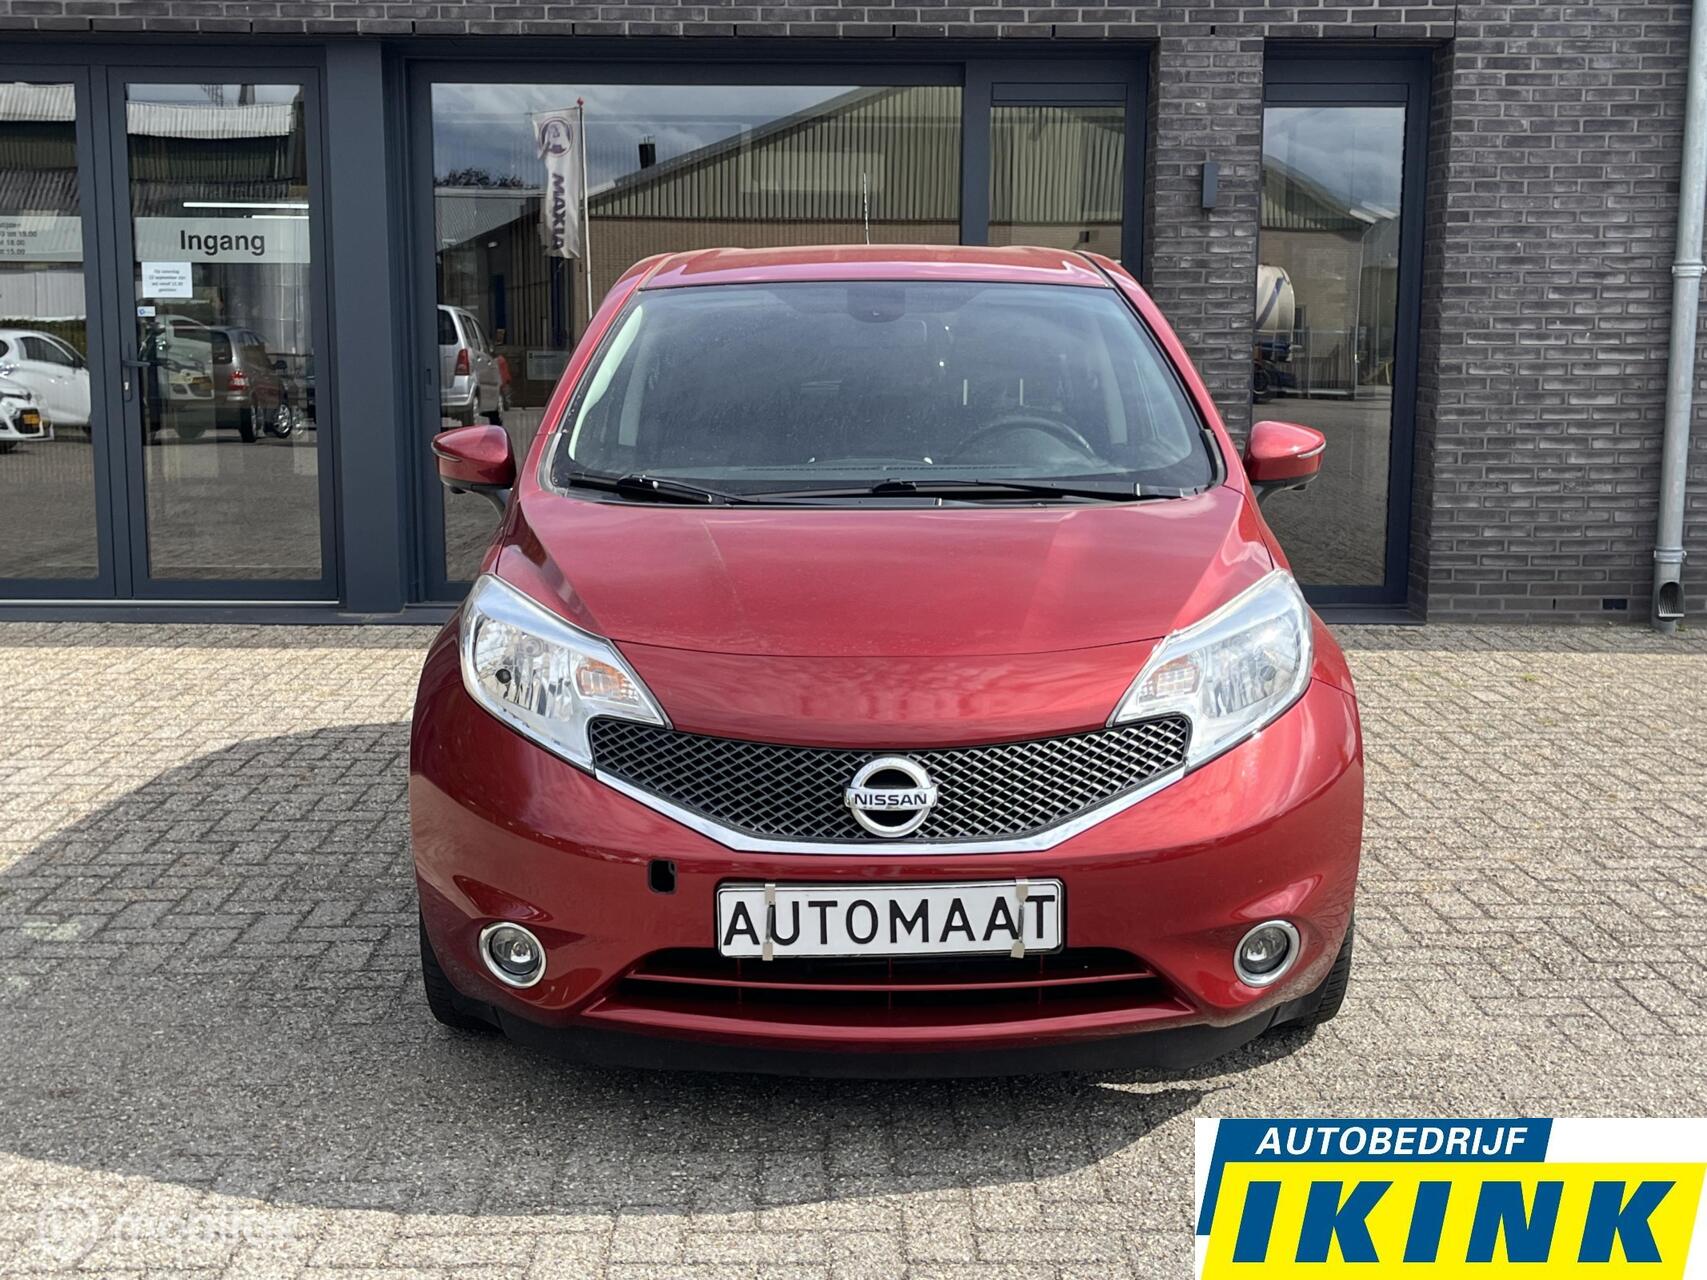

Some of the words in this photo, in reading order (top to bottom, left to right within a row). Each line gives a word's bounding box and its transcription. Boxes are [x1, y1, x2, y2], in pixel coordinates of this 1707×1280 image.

[180, 230, 265, 256] Ingang
[854, 793, 928, 806] NISSAN
[723, 894, 1056, 946] AUTOMAAT
